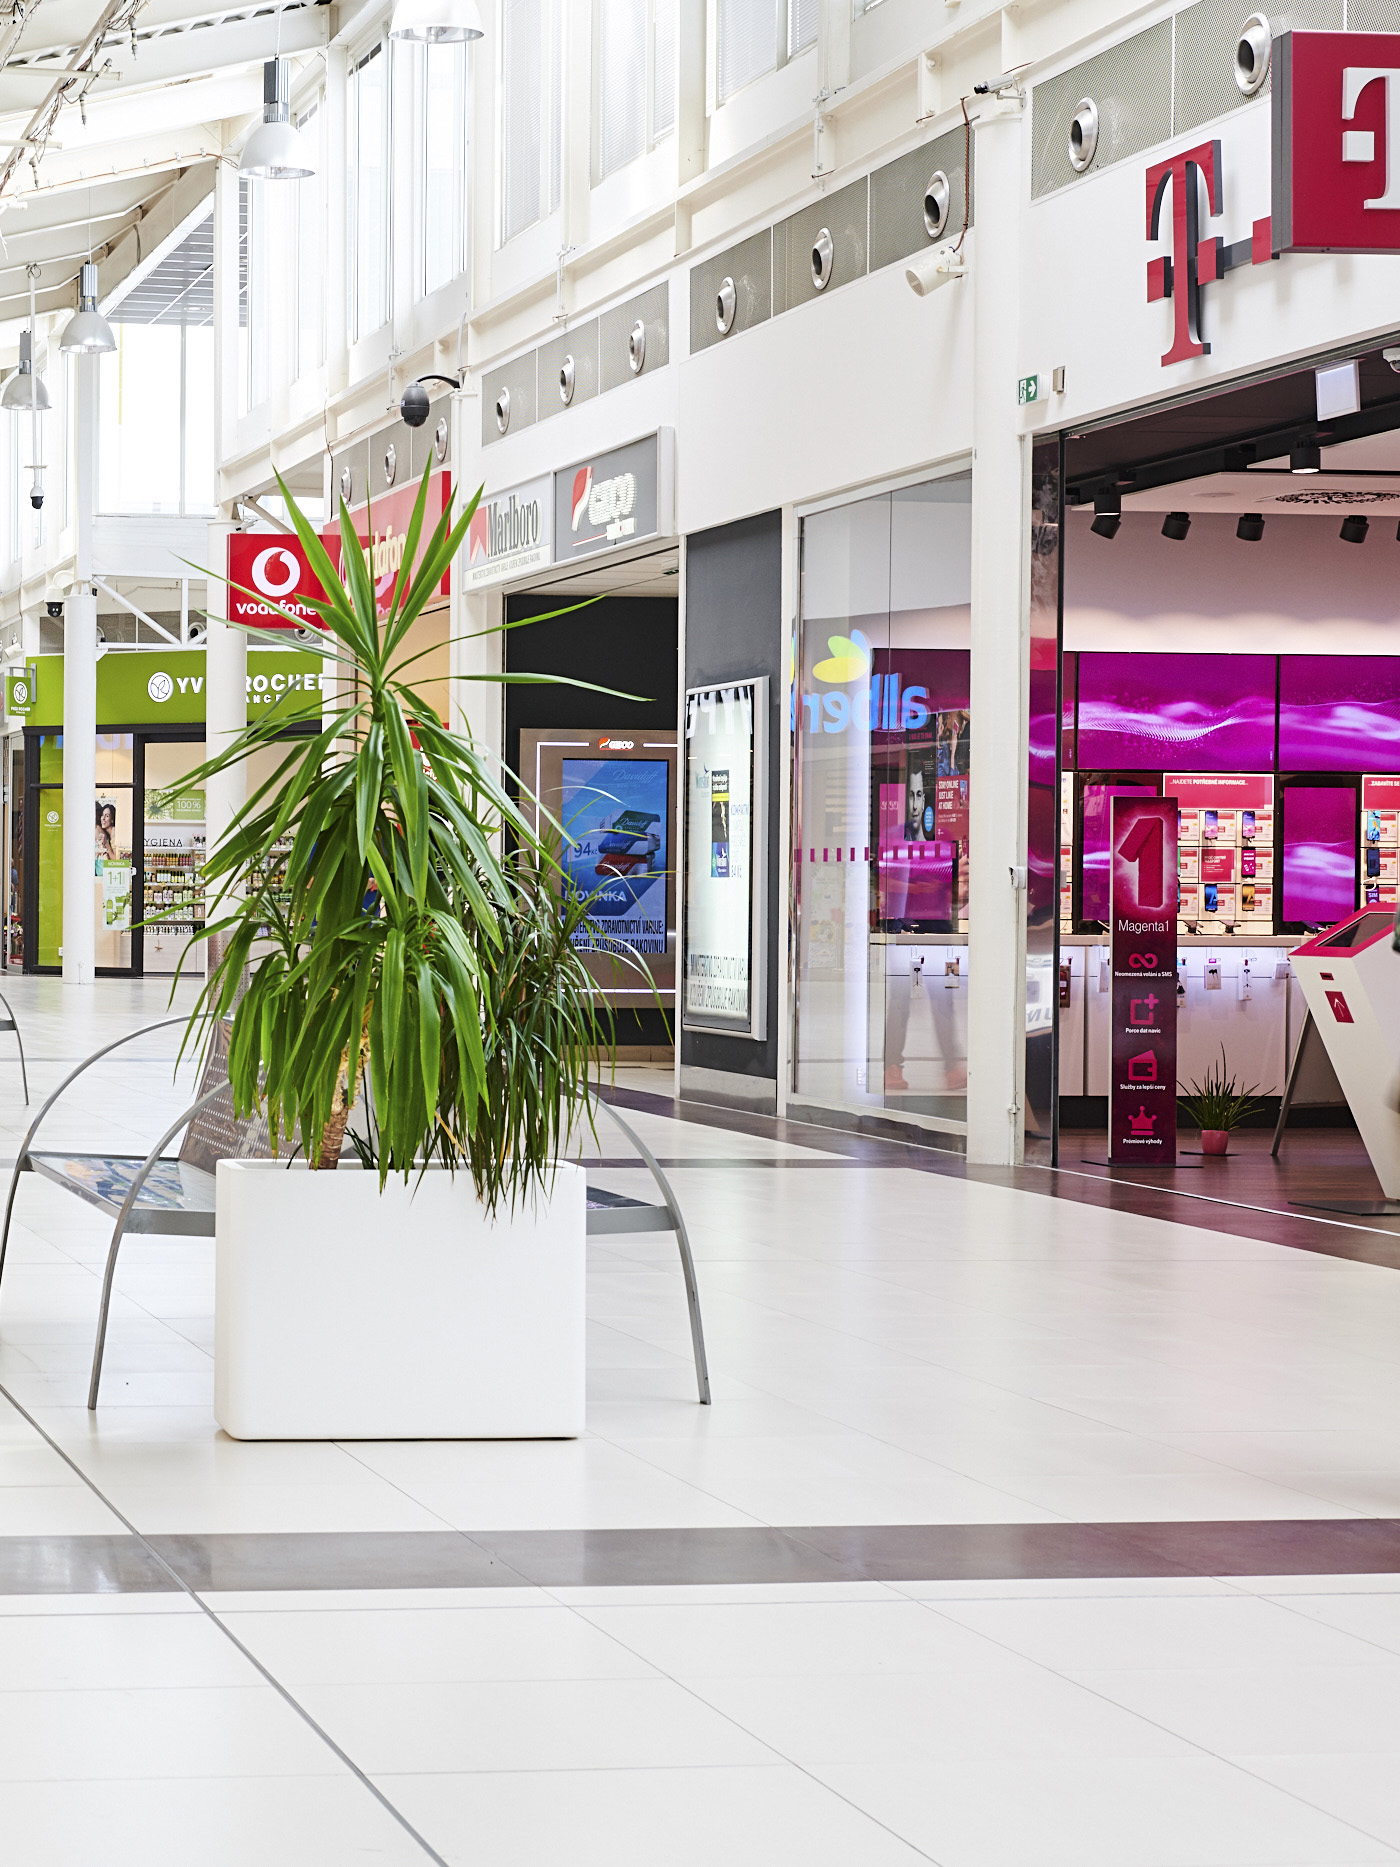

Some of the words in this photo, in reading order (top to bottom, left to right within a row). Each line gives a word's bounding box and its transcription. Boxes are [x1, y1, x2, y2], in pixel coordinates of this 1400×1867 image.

[487, 493, 540, 558] Marlboro
[176, 676, 204, 694] YV
[177, 800, 192, 809] 100
[144, 838, 183, 848] YGIENA
[574, 841, 591, 859] 94
[1118, 816, 1164, 909] 1
[107, 871, 123, 886] 1+1
[564, 890, 627, 902] NOVNKA
[1118, 919, 1170, 935] Magenta1
[1120, 1083, 1136, 1091] Služby
[1145, 1138, 1163, 1146] výhody
